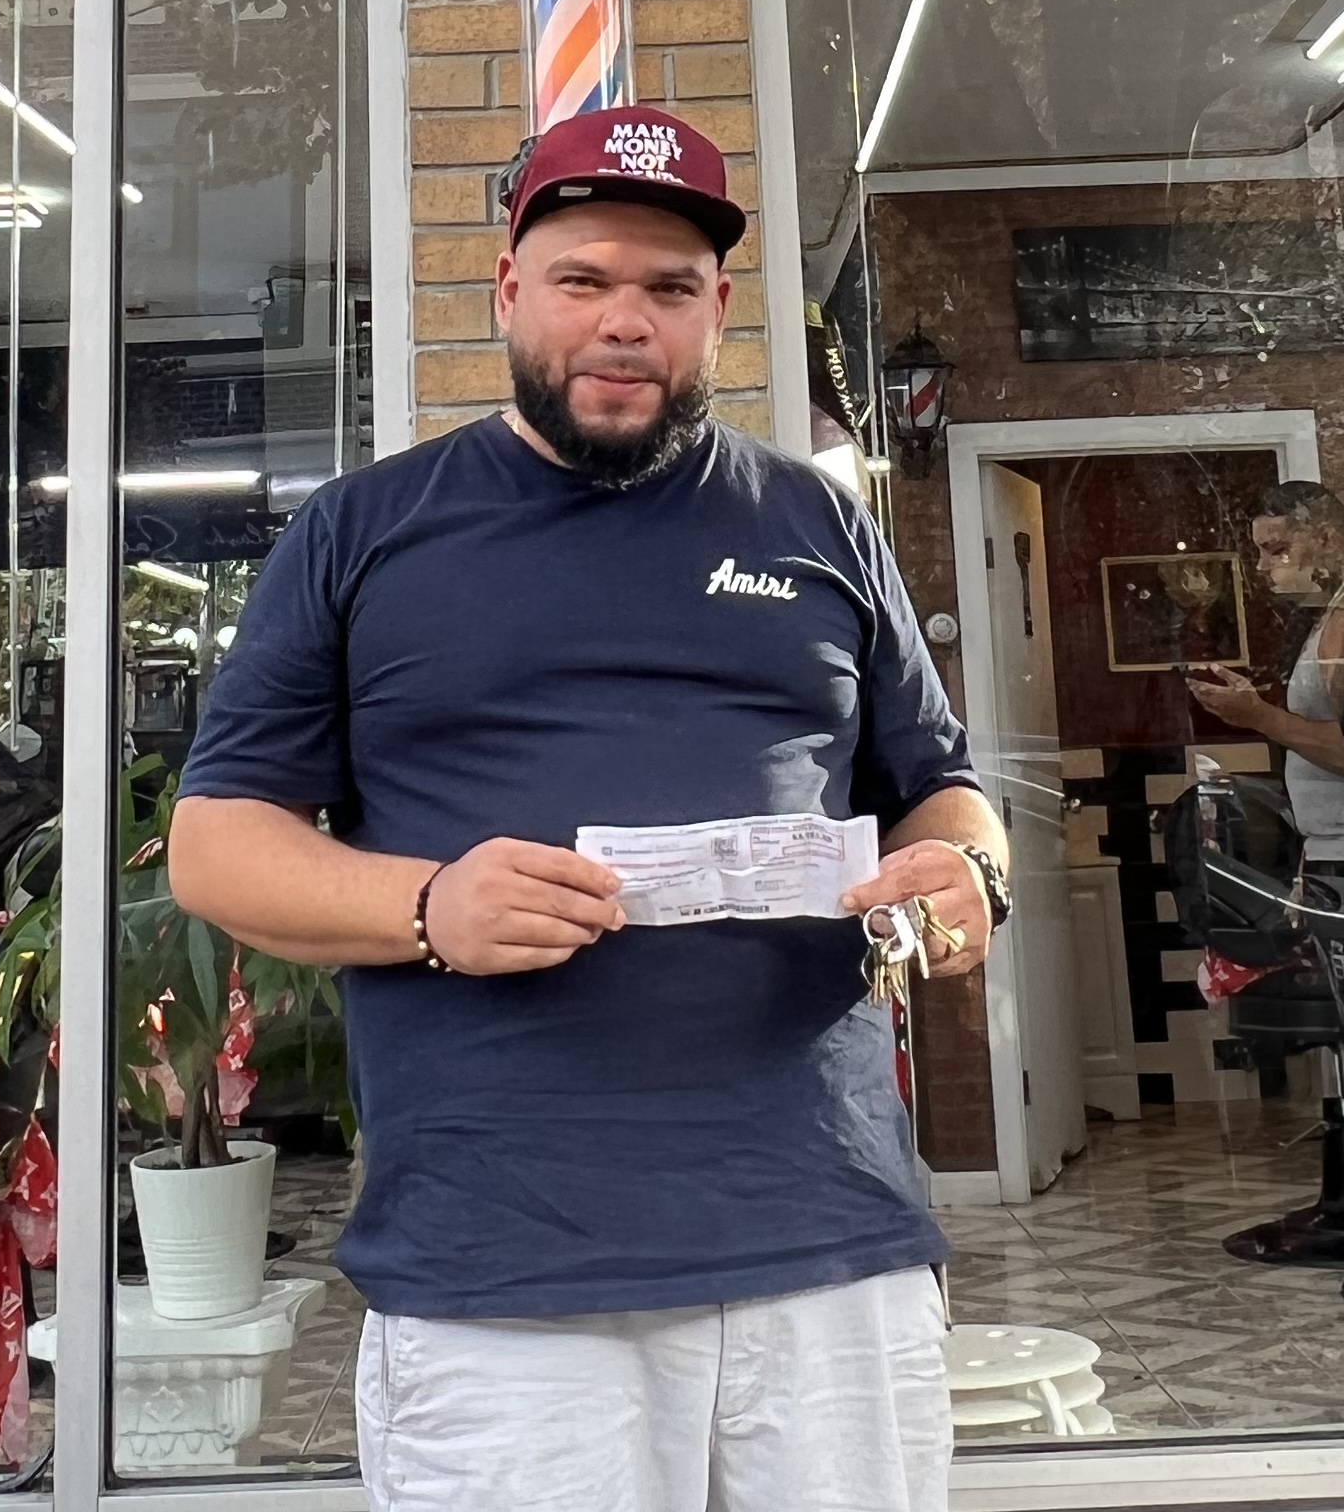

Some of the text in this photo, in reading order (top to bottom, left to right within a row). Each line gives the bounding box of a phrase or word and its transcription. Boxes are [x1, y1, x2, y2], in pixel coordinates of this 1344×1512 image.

[612, 123, 677, 143] MAKE
[604, 138, 683, 161] MONEY
[620, 153, 669, 170] NOT
[705, 558, 798, 600] Amiri
